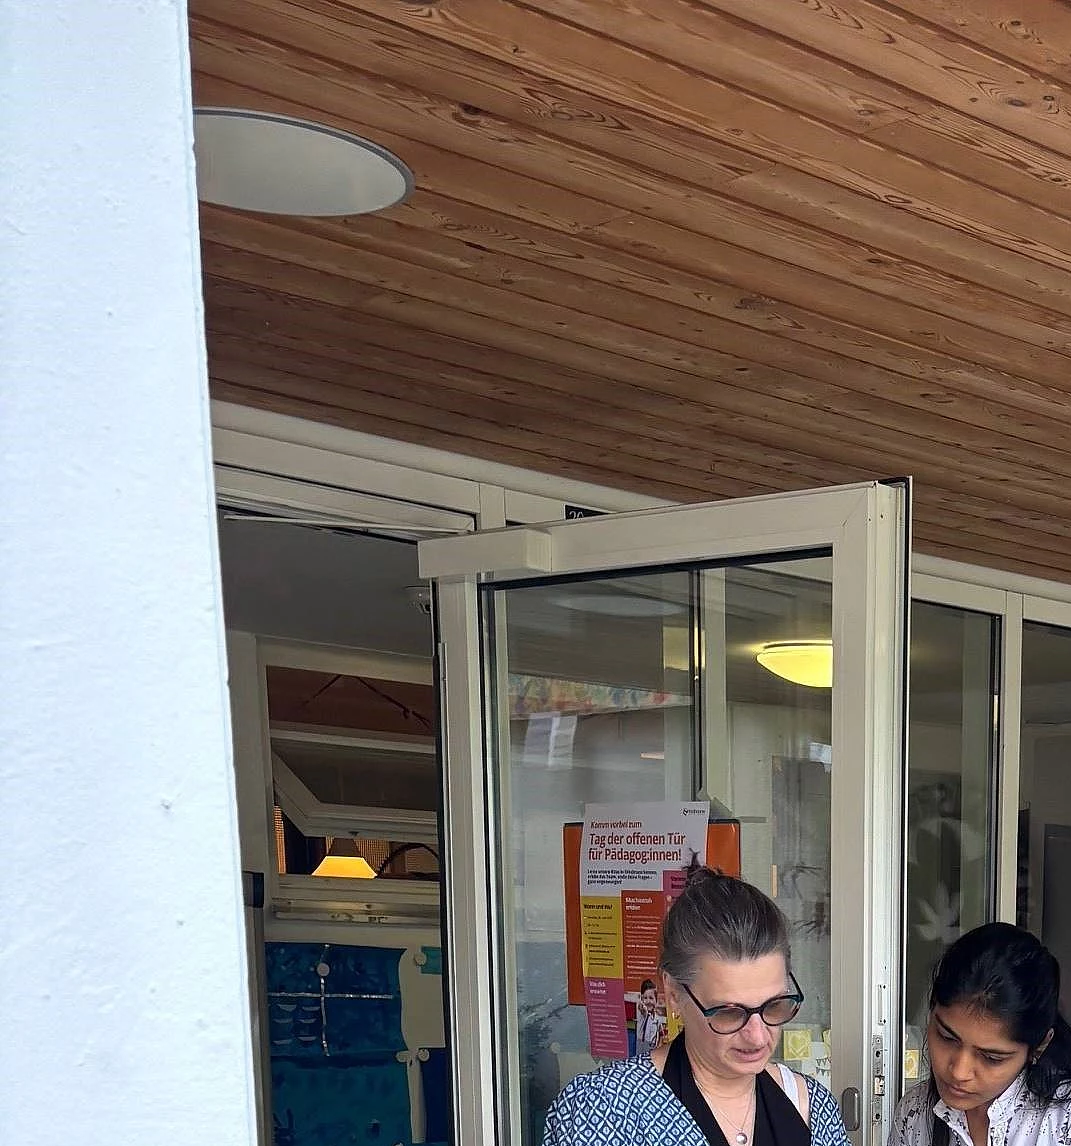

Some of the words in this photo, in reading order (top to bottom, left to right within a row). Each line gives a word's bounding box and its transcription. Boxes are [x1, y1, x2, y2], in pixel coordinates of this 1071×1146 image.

[590, 833, 605, 848] Tag
[608, 832, 624, 845] der
[626, 832, 665, 845] offenen
[668, 832, 686, 845] Tür
[588, 848, 602, 861] für
[605, 848, 681, 865] Pädagog:innen!
